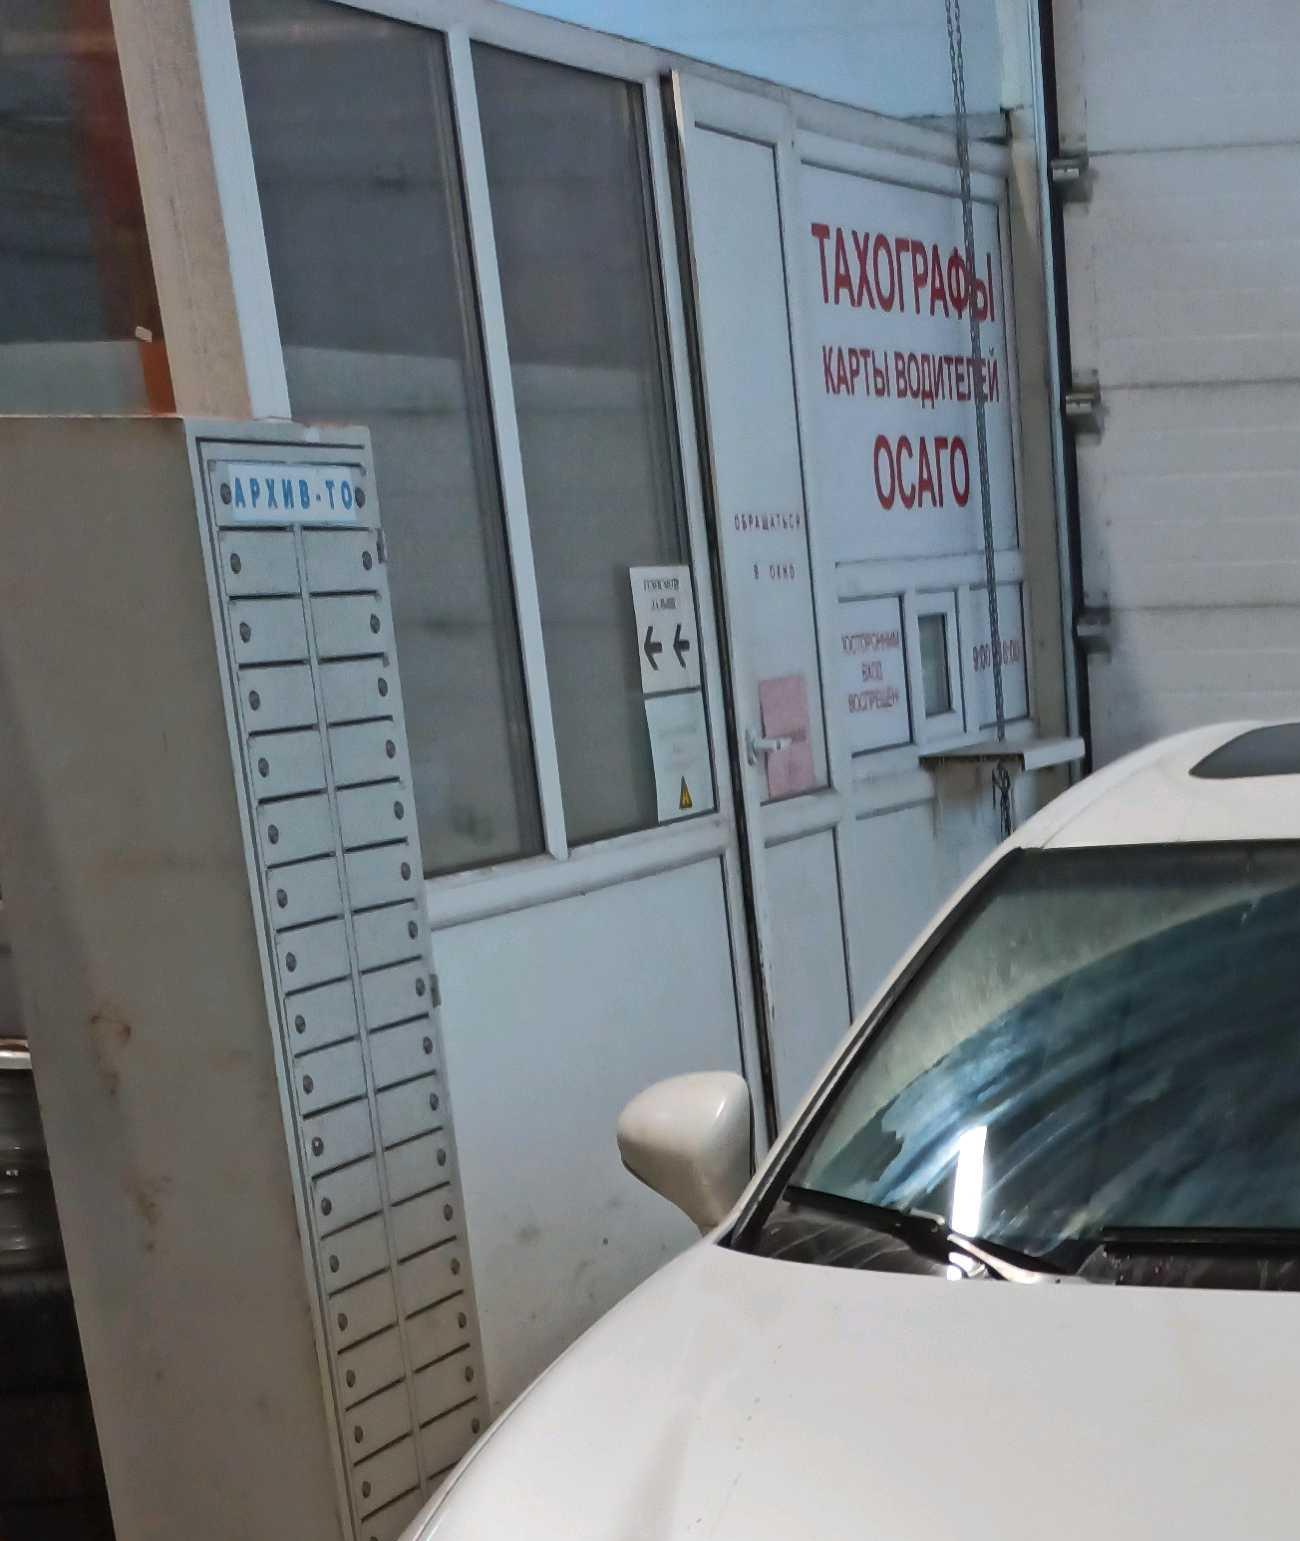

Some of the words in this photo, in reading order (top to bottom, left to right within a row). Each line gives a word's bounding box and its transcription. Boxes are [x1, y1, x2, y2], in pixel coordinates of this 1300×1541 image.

[811, 222, 995, 322] ТАХОГРАФЫ
[822, 345, 890, 397] КАРТЫ
[894, 348, 1000, 409] ВОДИТЕЛЕЙ
[233, 477, 353, 510] АРХИВ-ТО
[873, 434, 970, 510] ОСАГО
